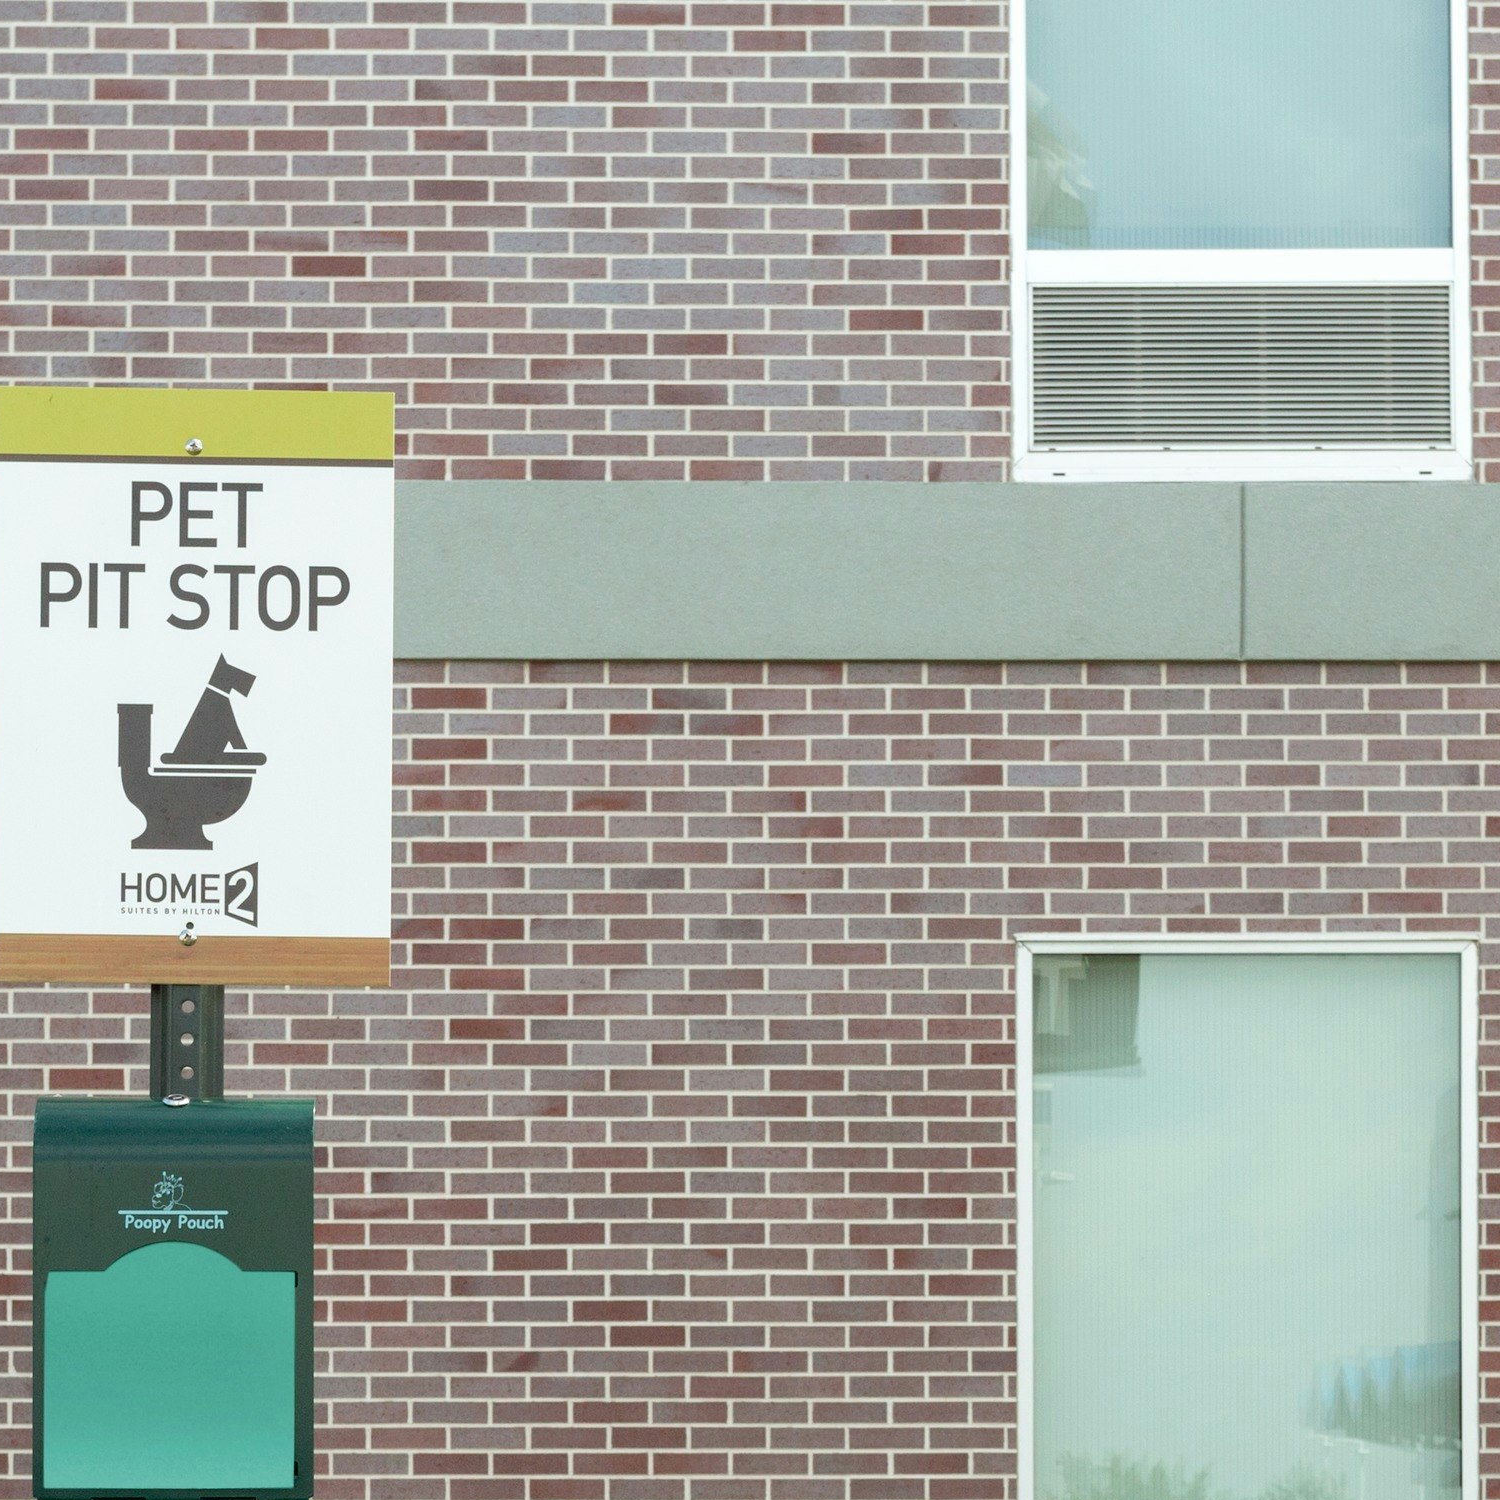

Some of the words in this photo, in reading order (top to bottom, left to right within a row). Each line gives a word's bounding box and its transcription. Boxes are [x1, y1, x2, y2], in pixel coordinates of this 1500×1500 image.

[131, 480, 264, 548] PET
[40, 562, 146, 629] PIT
[166, 563, 350, 632] STOP
[120, 906, 159, 915] SUITES
[164, 907, 177, 915] BY
[182, 907, 221, 916] HILTON
[125, 1214, 172, 1234] Poopy
[177, 1214, 225, 1230] Pouch
